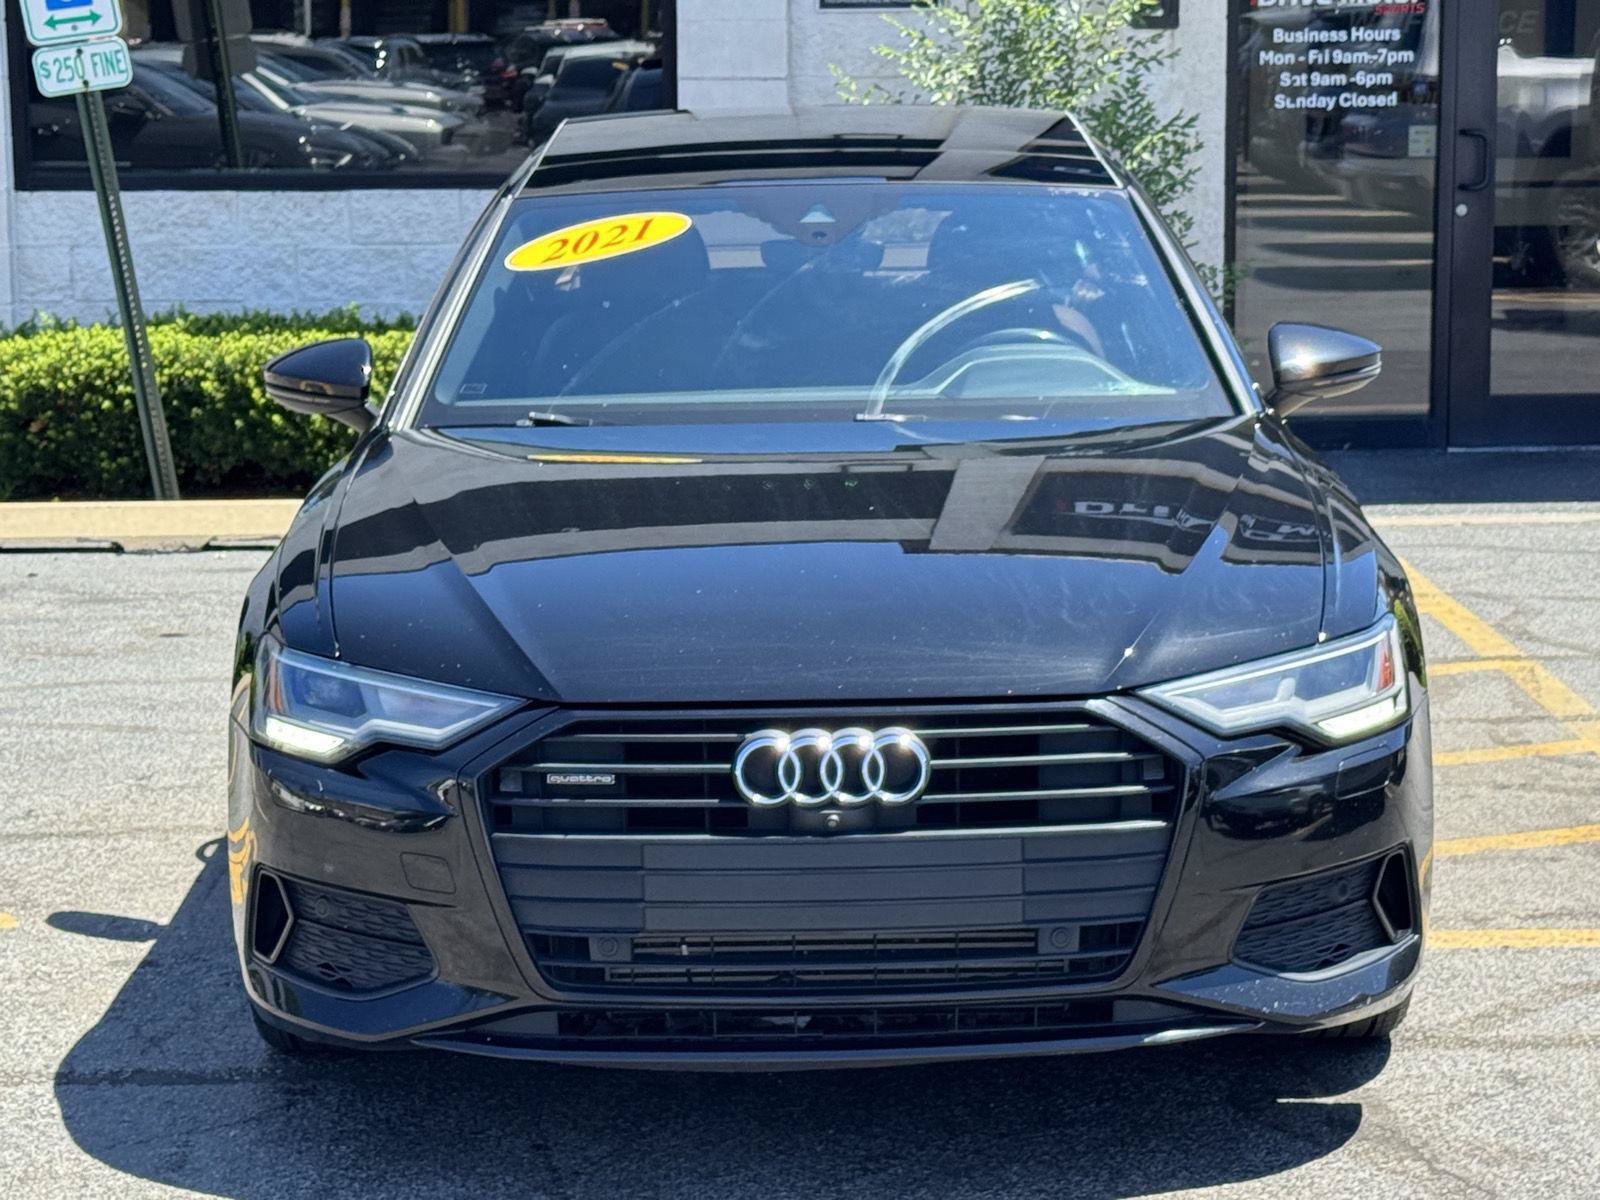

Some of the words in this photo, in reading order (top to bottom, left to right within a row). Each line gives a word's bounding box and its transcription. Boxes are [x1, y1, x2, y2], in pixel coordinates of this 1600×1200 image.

[1272, 27, 1348, 43] Business
[1351, 26, 1401, 43] Hours
[38, 54, 85, 83] $250
[90, 49, 127, 78] FINE
[1259, 50, 1295, 65] Mon
[1279, 71, 1308, 87] Sat
[1274, 93, 1337, 111] Sunday
[1339, 91, 1398, 108] Closed
[541, 218, 656, 264] 2021
[550, 774, 612, 784] quattro
